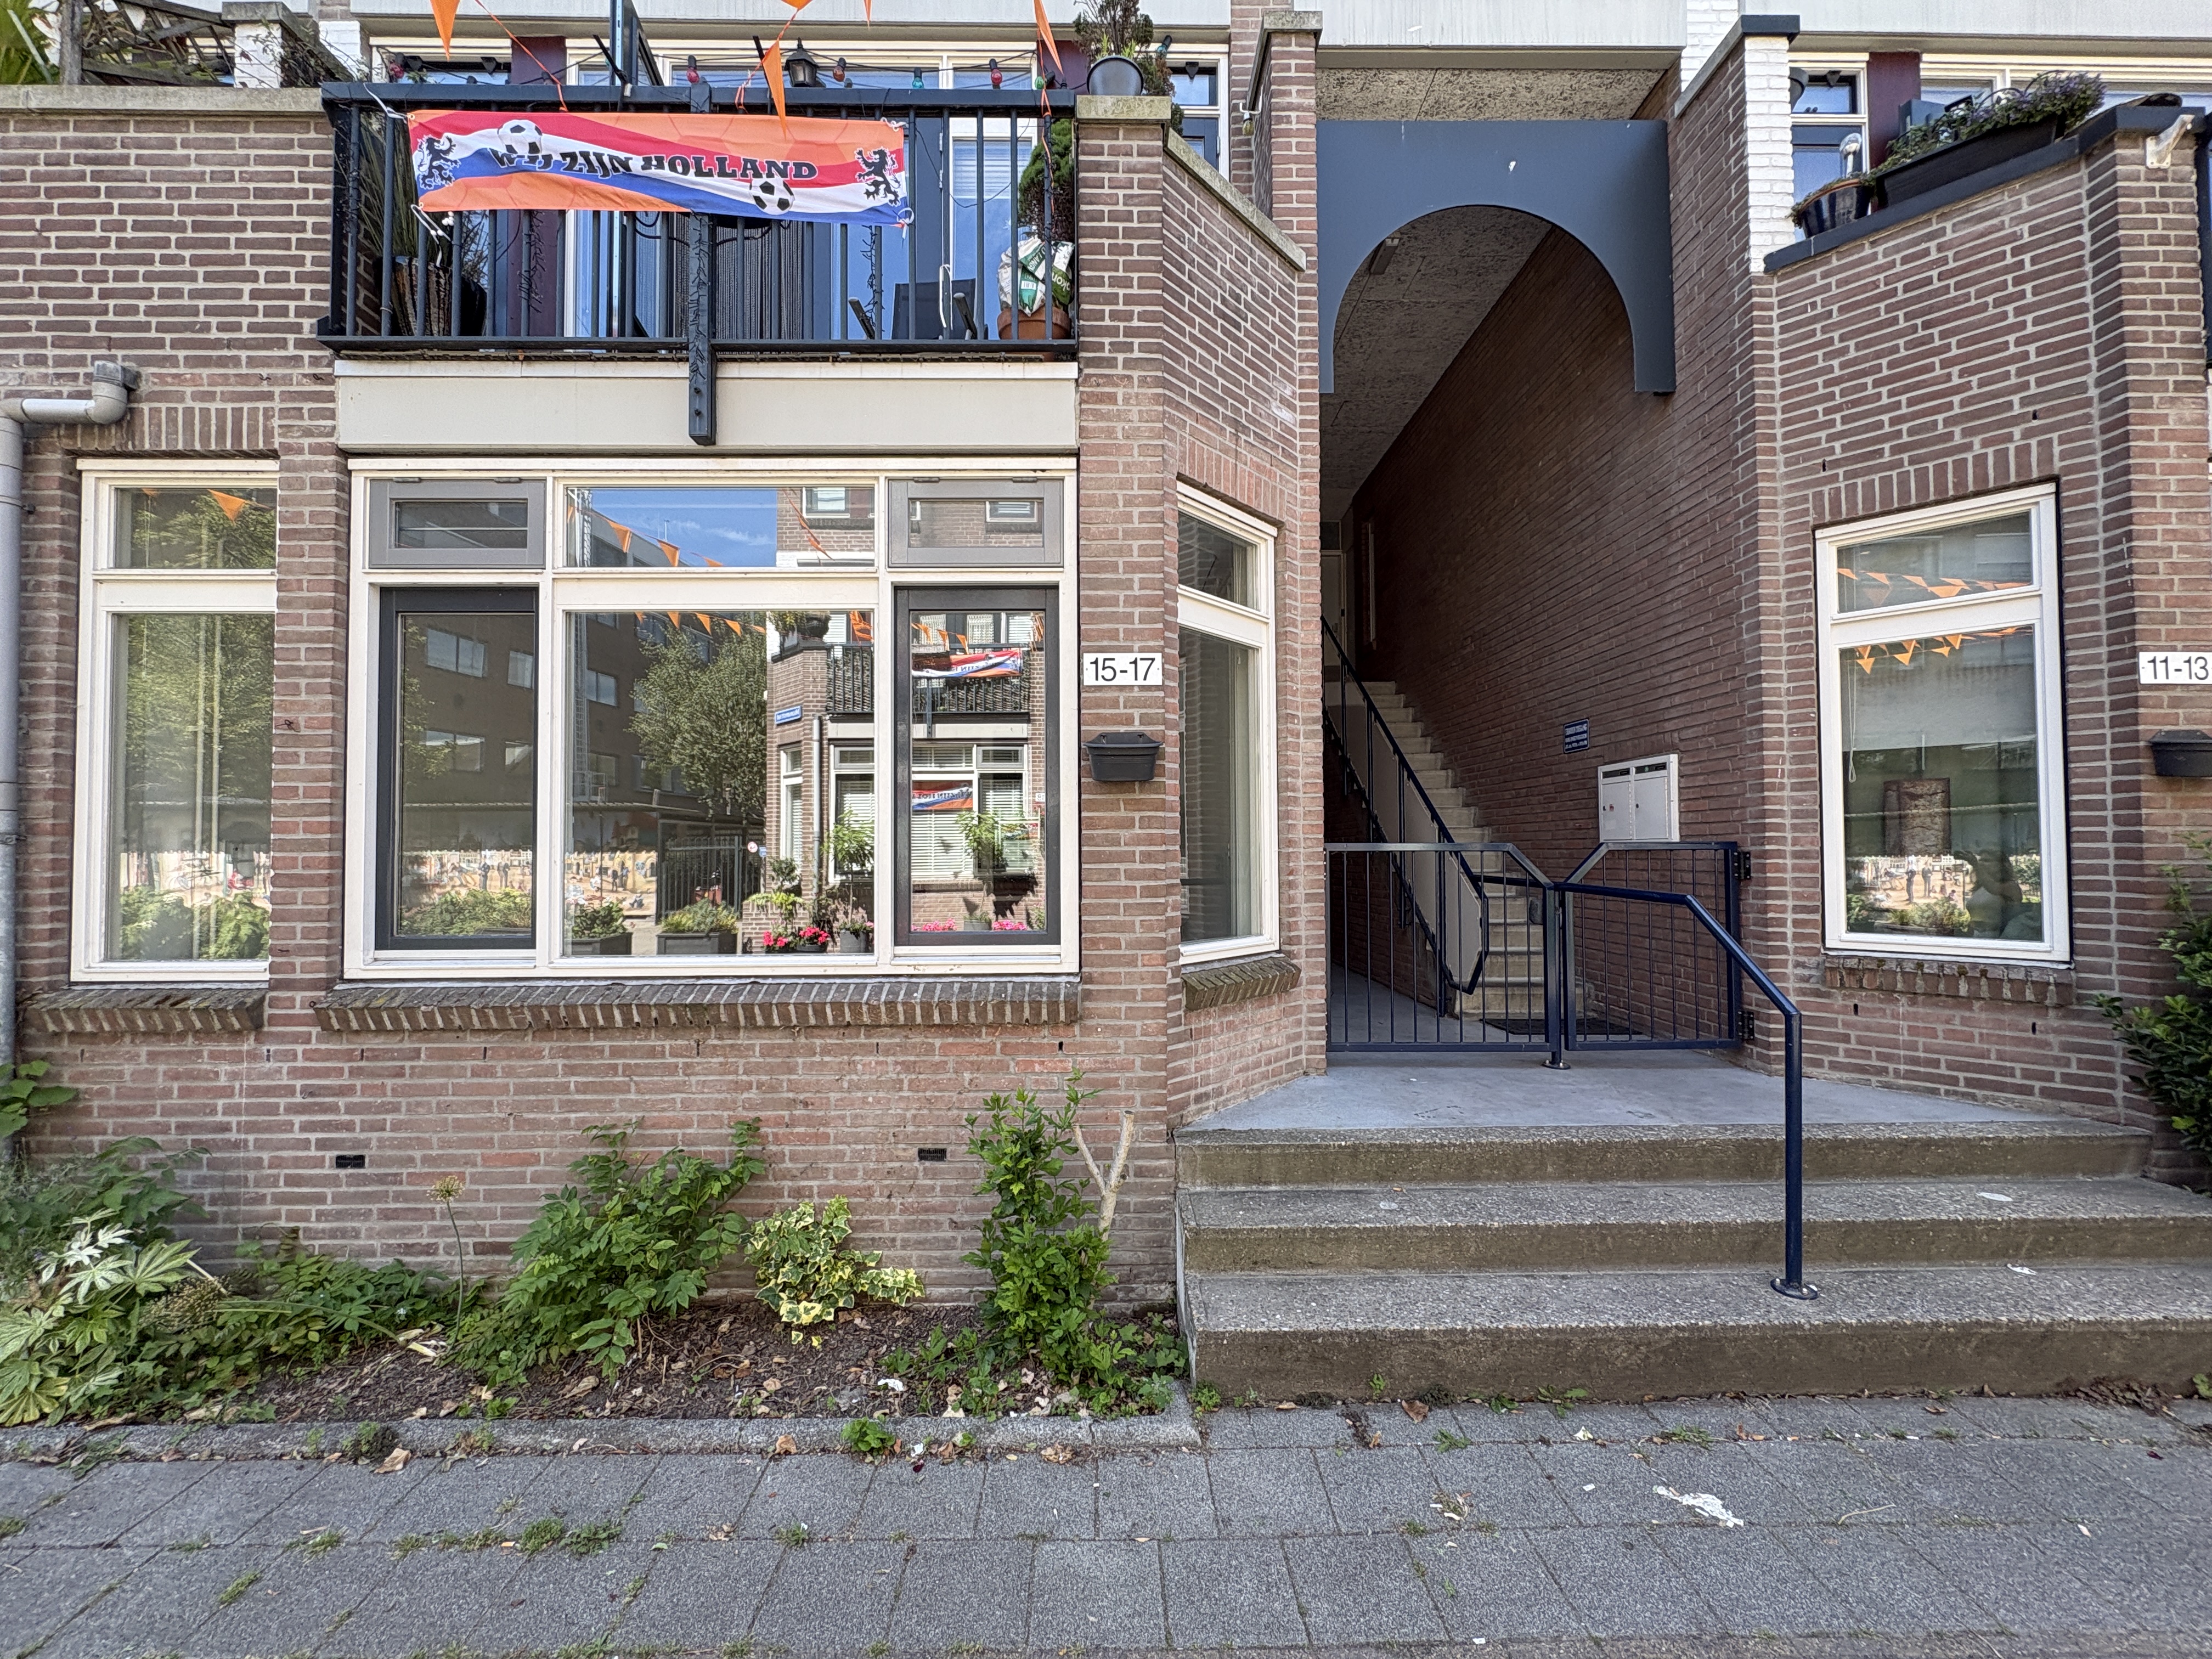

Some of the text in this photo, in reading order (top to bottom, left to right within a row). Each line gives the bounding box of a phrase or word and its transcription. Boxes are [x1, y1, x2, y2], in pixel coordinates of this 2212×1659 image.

[488, 148, 817, 179] WIJ ZIJN HOLLAND
[1090, 657, 1155, 681] 15-17
[2147, 656, 2209, 680] 11-13
